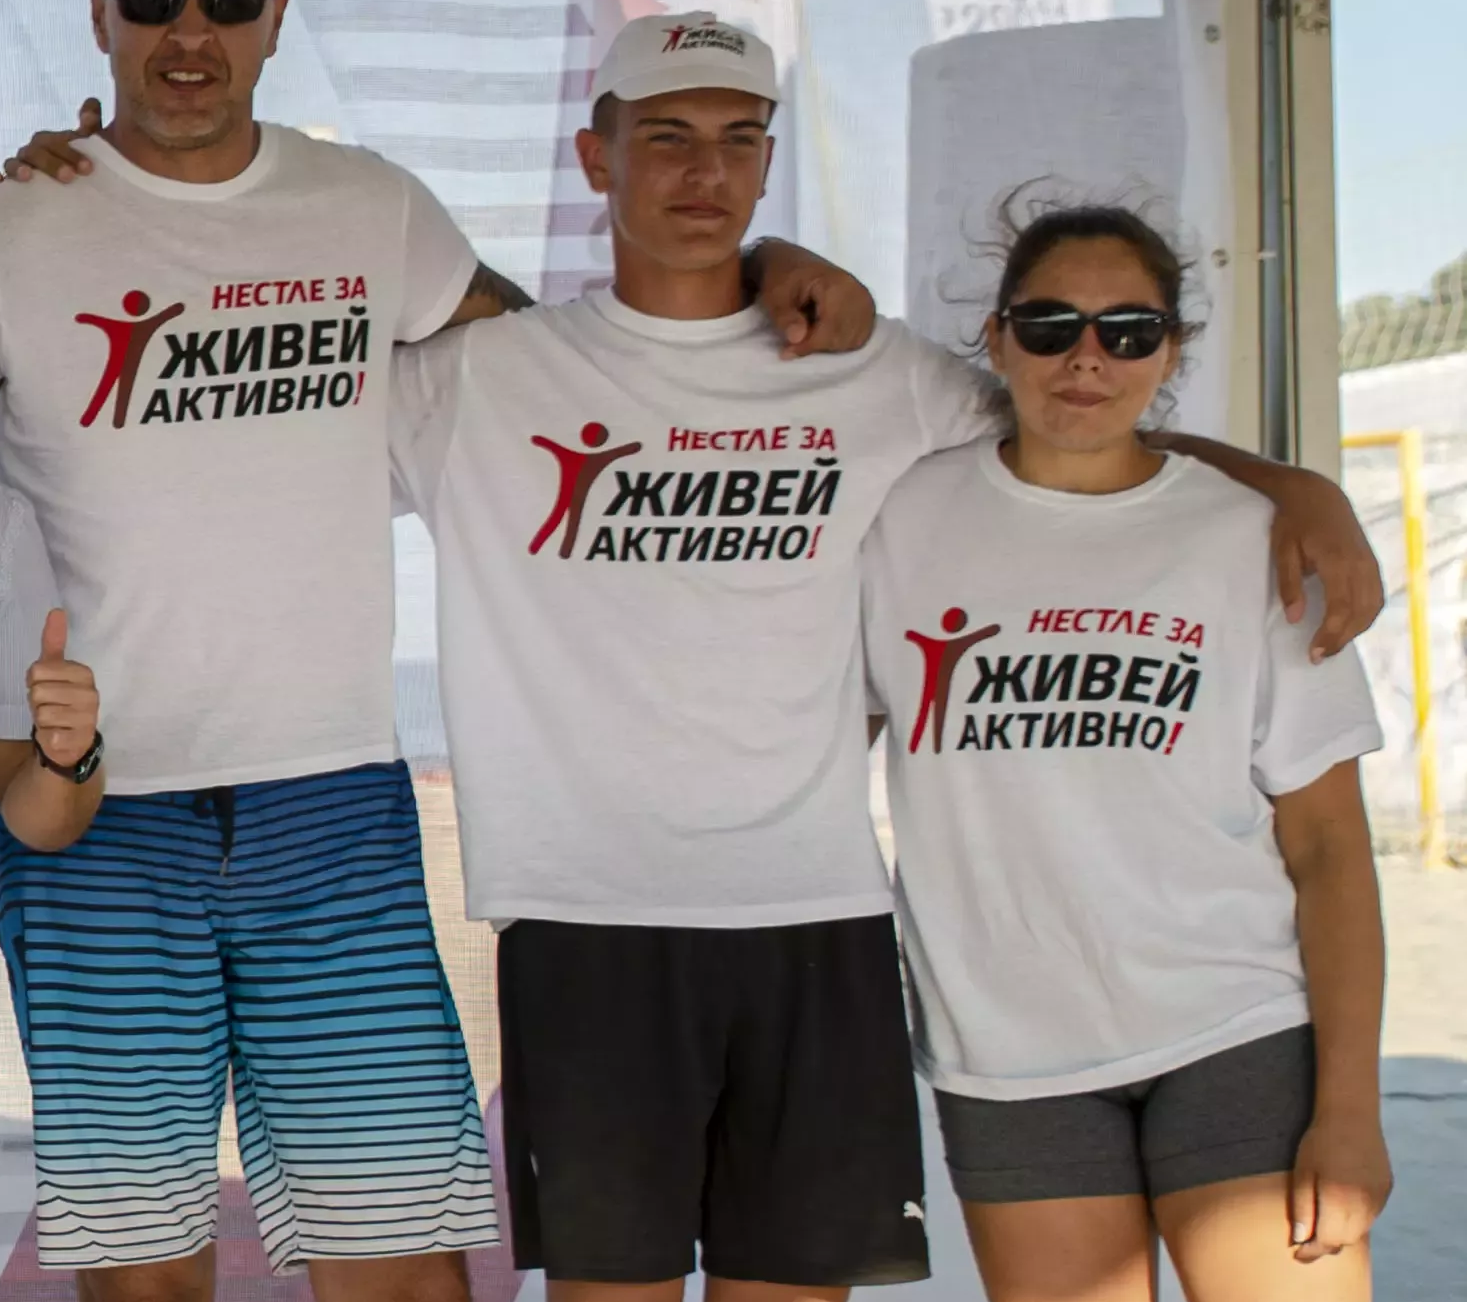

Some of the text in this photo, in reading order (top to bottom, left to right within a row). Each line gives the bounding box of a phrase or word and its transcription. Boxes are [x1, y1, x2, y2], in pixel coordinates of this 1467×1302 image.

[211, 275, 368, 310] НЕСТЛЕ ЗА
[157, 305, 371, 380] ЖИВЕЙ
[139, 370, 366, 425] АКТИВНО!
[667, 425, 837, 452] НЕСТЛЕ ЗА
[602, 456, 843, 517] ЖИВЕЙ
[584, 524, 825, 563] АКТИВНО!
[1026, 607, 1205, 650] НЕСТЛЕ ЗА
[965, 650, 1202, 713] ЖИВЕЙ
[955, 711, 1185, 757] АКТИВНО!
